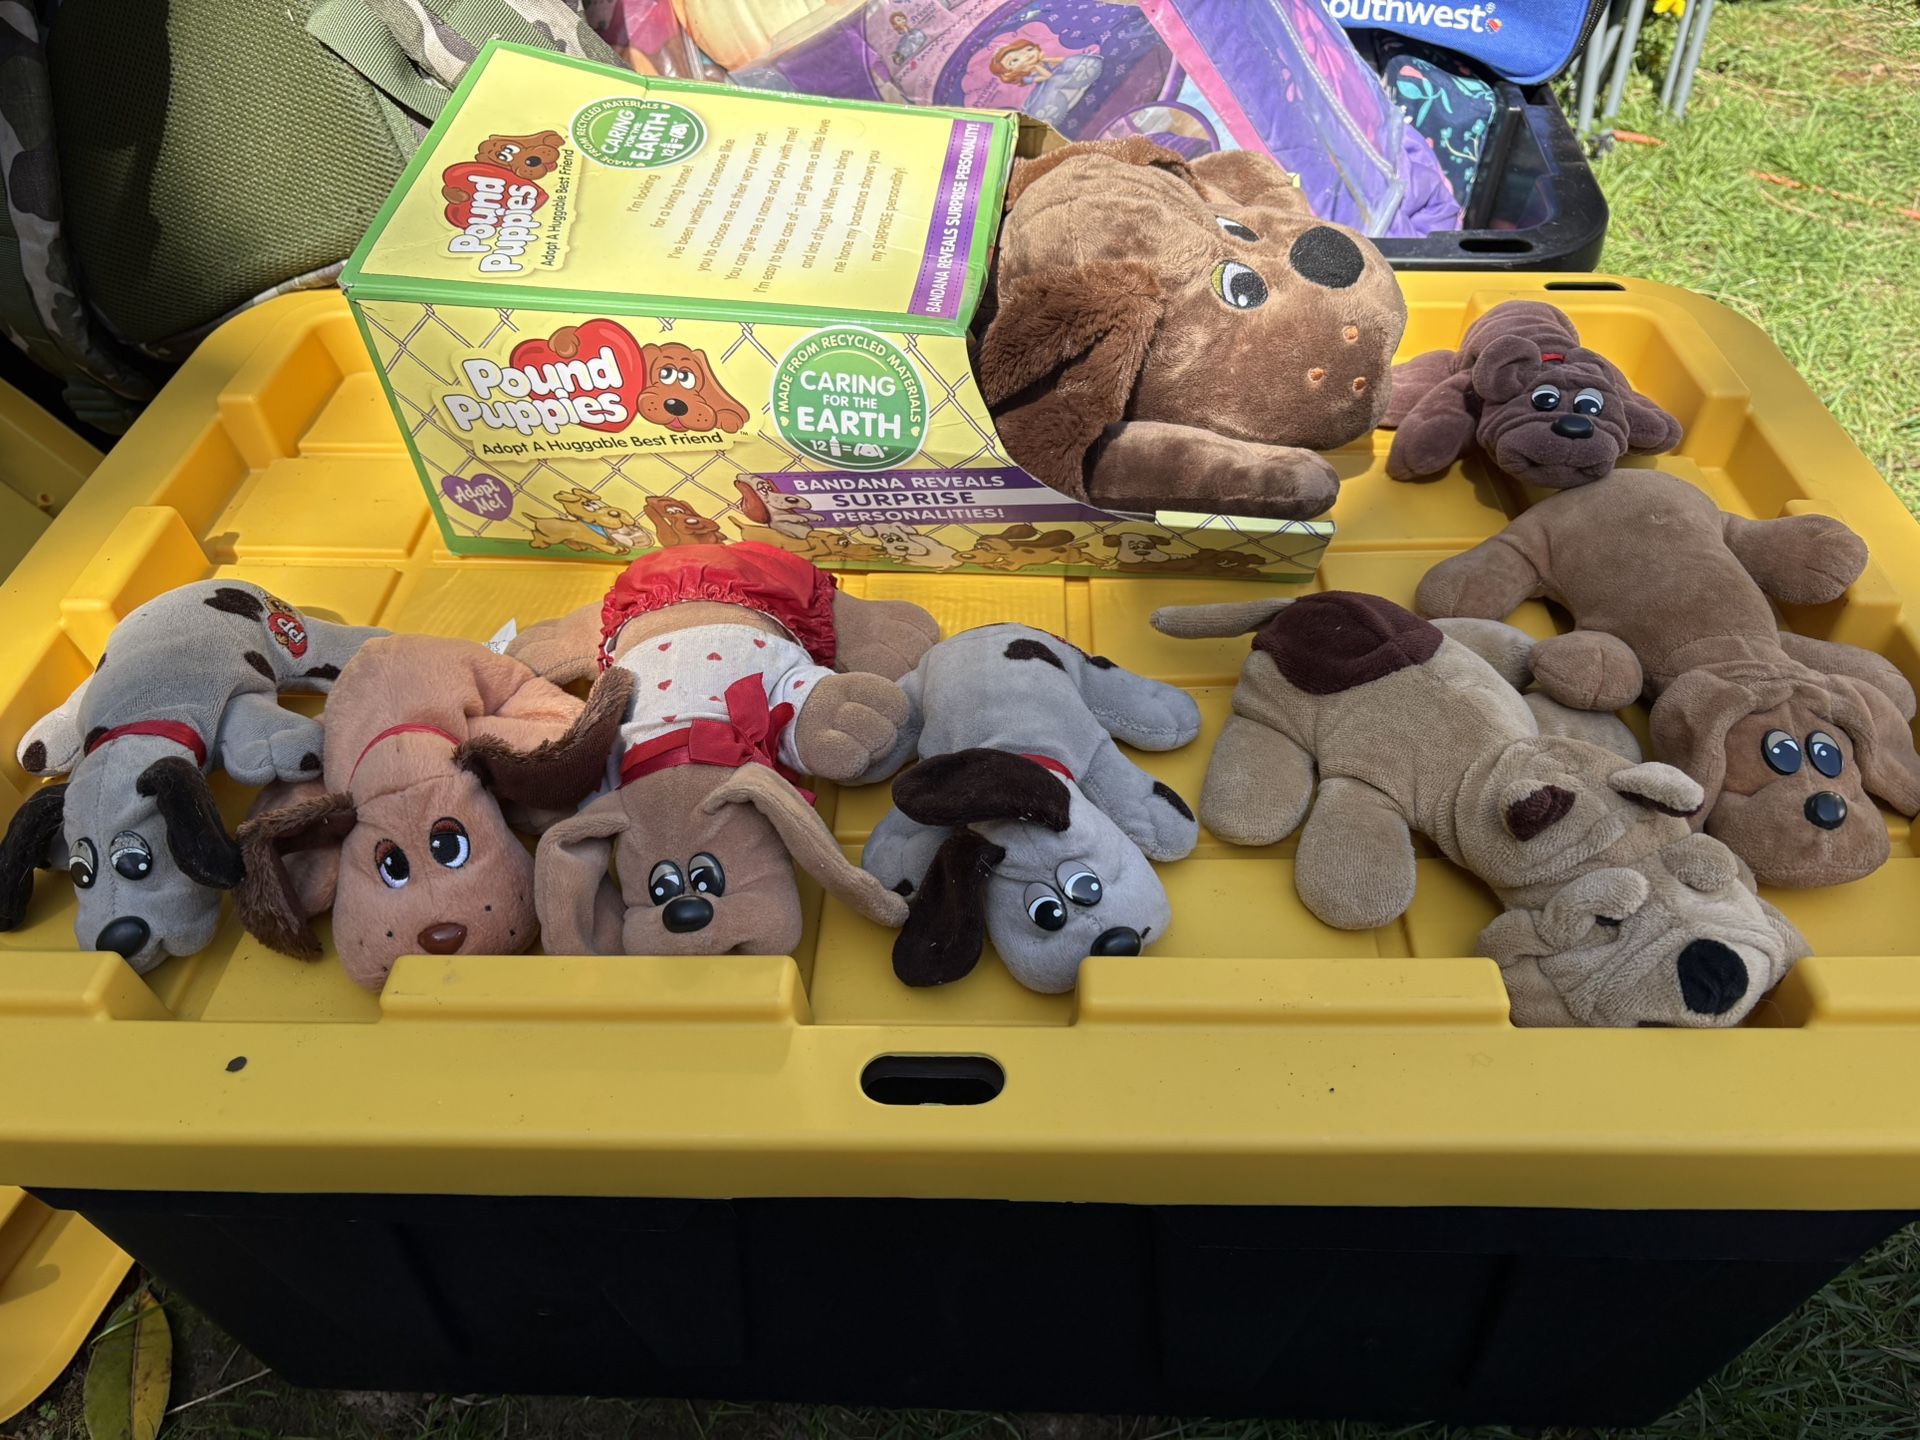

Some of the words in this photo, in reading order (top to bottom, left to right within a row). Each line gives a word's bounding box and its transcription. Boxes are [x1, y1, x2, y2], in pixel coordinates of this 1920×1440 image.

[1324, 0, 1486, 33] outhwest
[602, 100, 659, 110] MATERIALS
[576, 106, 601, 136] RECYCLED
[814, 118, 831, 136] love
[601, 109, 635, 154] CARING
[630, 112, 671, 160] EARTH
[786, 127, 799, 143] me!
[579, 138, 601, 157] FROM
[661, 148, 676, 157] 12
[719, 138, 735, 155] like
[779, 144, 793, 161] with
[809, 136, 825, 153] little
[955, 123, 980, 180] PERSONALITY!
[558, 149, 574, 176] Friend
[600, 156, 633, 166] MADE
[748, 147, 762, 165] own
[833, 149, 854, 170] bring
[869, 149, 881, 165] you
[707, 154, 730, 188] someone
[742, 166, 758, 182] very
[772, 161, 790, 180] play
[806, 161, 818, 174] me
[555, 175, 570, 194] Best
[768, 179, 780, 195] and
[798, 174, 813, 192] give
[833, 170, 845, 186] you
[858, 165, 876, 190] shows
[627, 199, 640, 213] I'm
[635, 174, 661, 200] looking
[650, 217, 666, 228] for
[664, 185, 685, 208] loving
[675, 165, 694, 188] home!
[698, 187, 714, 200] for
[731, 183, 748, 202] their
[821, 186, 839, 210] When
[885, 167, 908, 211] personality!
[547, 194, 567, 232] Huggable
[688, 197, 712, 226] waiting
[757, 195, 774, 219] name
[847, 192, 869, 227] bandana
[946, 181, 967, 226] SURPRISE
[448, 175, 506, 252] Pound
[723, 209, 736, 222] me
[817, 211, 833, 233] hugs!
[479, 184, 542, 272] Puppies
[550, 232, 559, 241] A
[675, 226, 695, 245] been
[708, 222, 730, 249] choose
[749, 222, 762, 236] me
[782, 221, 796, 238] care
[846, 227, 862, 240] my
[872, 213, 894, 250] SURPRISE
[541, 238, 555, 266] Adopt
[667, 245, 685, 259] I've
[741, 235, 756, 252] give
[773, 237, 789, 255] take
[806, 241, 820, 254] lots
[839, 239, 855, 262] home
[937, 228, 958, 269] REVEALS
[698, 258, 712, 272] you
[736, 252, 749, 267] can
[802, 254, 815, 269] and
[871, 251, 887, 262] my
[724, 267, 742, 280] You
[762, 264, 782, 281] easy
[834, 261, 847, 273] me
[753, 281, 770, 293] I'm
[926, 270, 950, 313] BANDANA
[462, 346, 624, 399] Pound
[778, 374, 793, 412] MADE
[786, 342, 819, 374] FROM
[821, 334, 886, 356] RECYCLED
[886, 354, 921, 423] MATERIALS
[800, 370, 896, 396] CARING
[443, 387, 629, 435] Puppies
[823, 394, 849, 407] FOR
[852, 396, 878, 409] THE
[797, 406, 901, 439] EARTH
[482, 442, 529, 456] Adopt
[533, 440, 545, 452] A
[549, 437, 627, 453] Huggable
[631, 434, 667, 448] Best
[670, 431, 724, 446] Friend
[810, 439, 828, 451] 12
[454, 478, 500, 503] Adopt
[793, 476, 906, 491] BANDANA
[911, 475, 1005, 489] REVEALS
[473, 493, 507, 514] Me!
[832, 491, 976, 507] SURPRISE
[831, 508, 1005, 523] PERSONALITIES!
